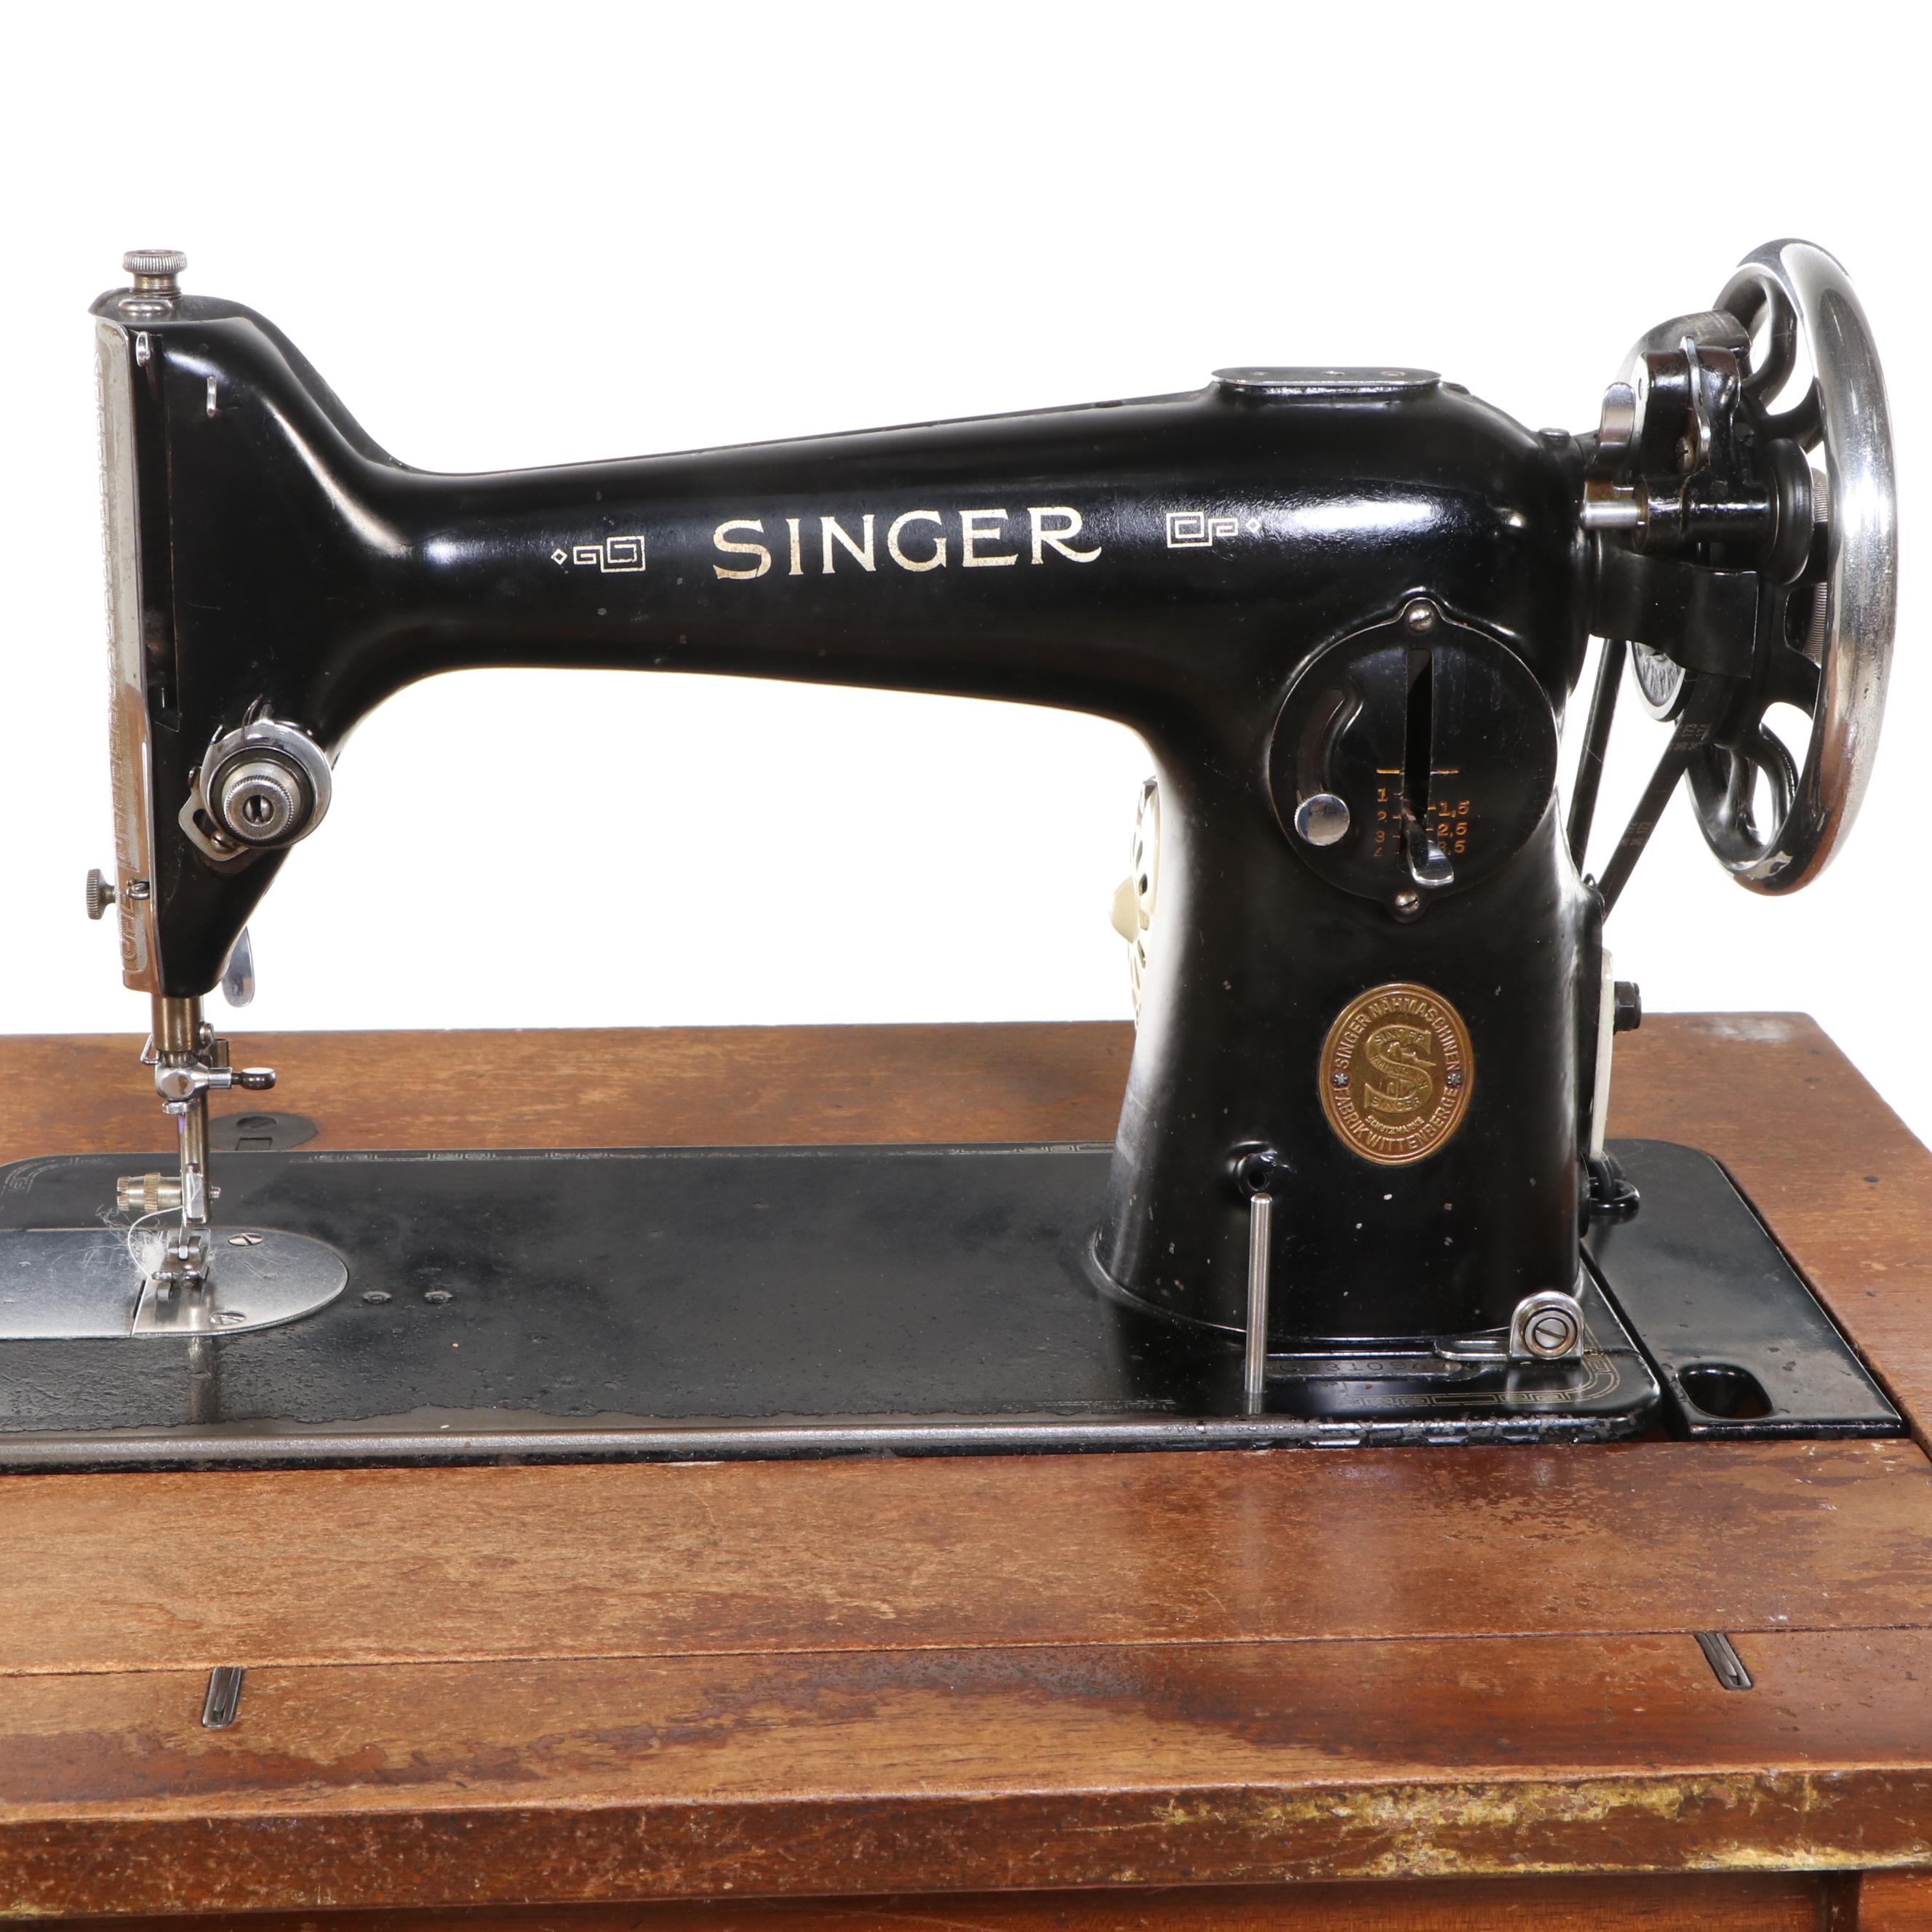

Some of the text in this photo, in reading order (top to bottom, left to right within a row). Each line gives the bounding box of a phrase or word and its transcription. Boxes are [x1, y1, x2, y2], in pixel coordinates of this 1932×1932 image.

[713, 506, 1102, 580] SINGER
[1377, 788, 1389, 802] 1
[1377, 811, 1388, 823] 2
[1438, 800, 1470, 818] 1,5
[1374, 831, 1385, 843] 3
[1437, 822, 1467, 837] 2,5
[1335, 1013, 1373, 1070] SINGER
[1374, 1027, 1425, 1046] SINGER
[1370, 1096, 1422, 1111] SINGER
[1333, 1087, 1458, 1152] FABRIK WITTENBERGE
[1365, 1115, 1425, 1135] SCHUTZMARKE
